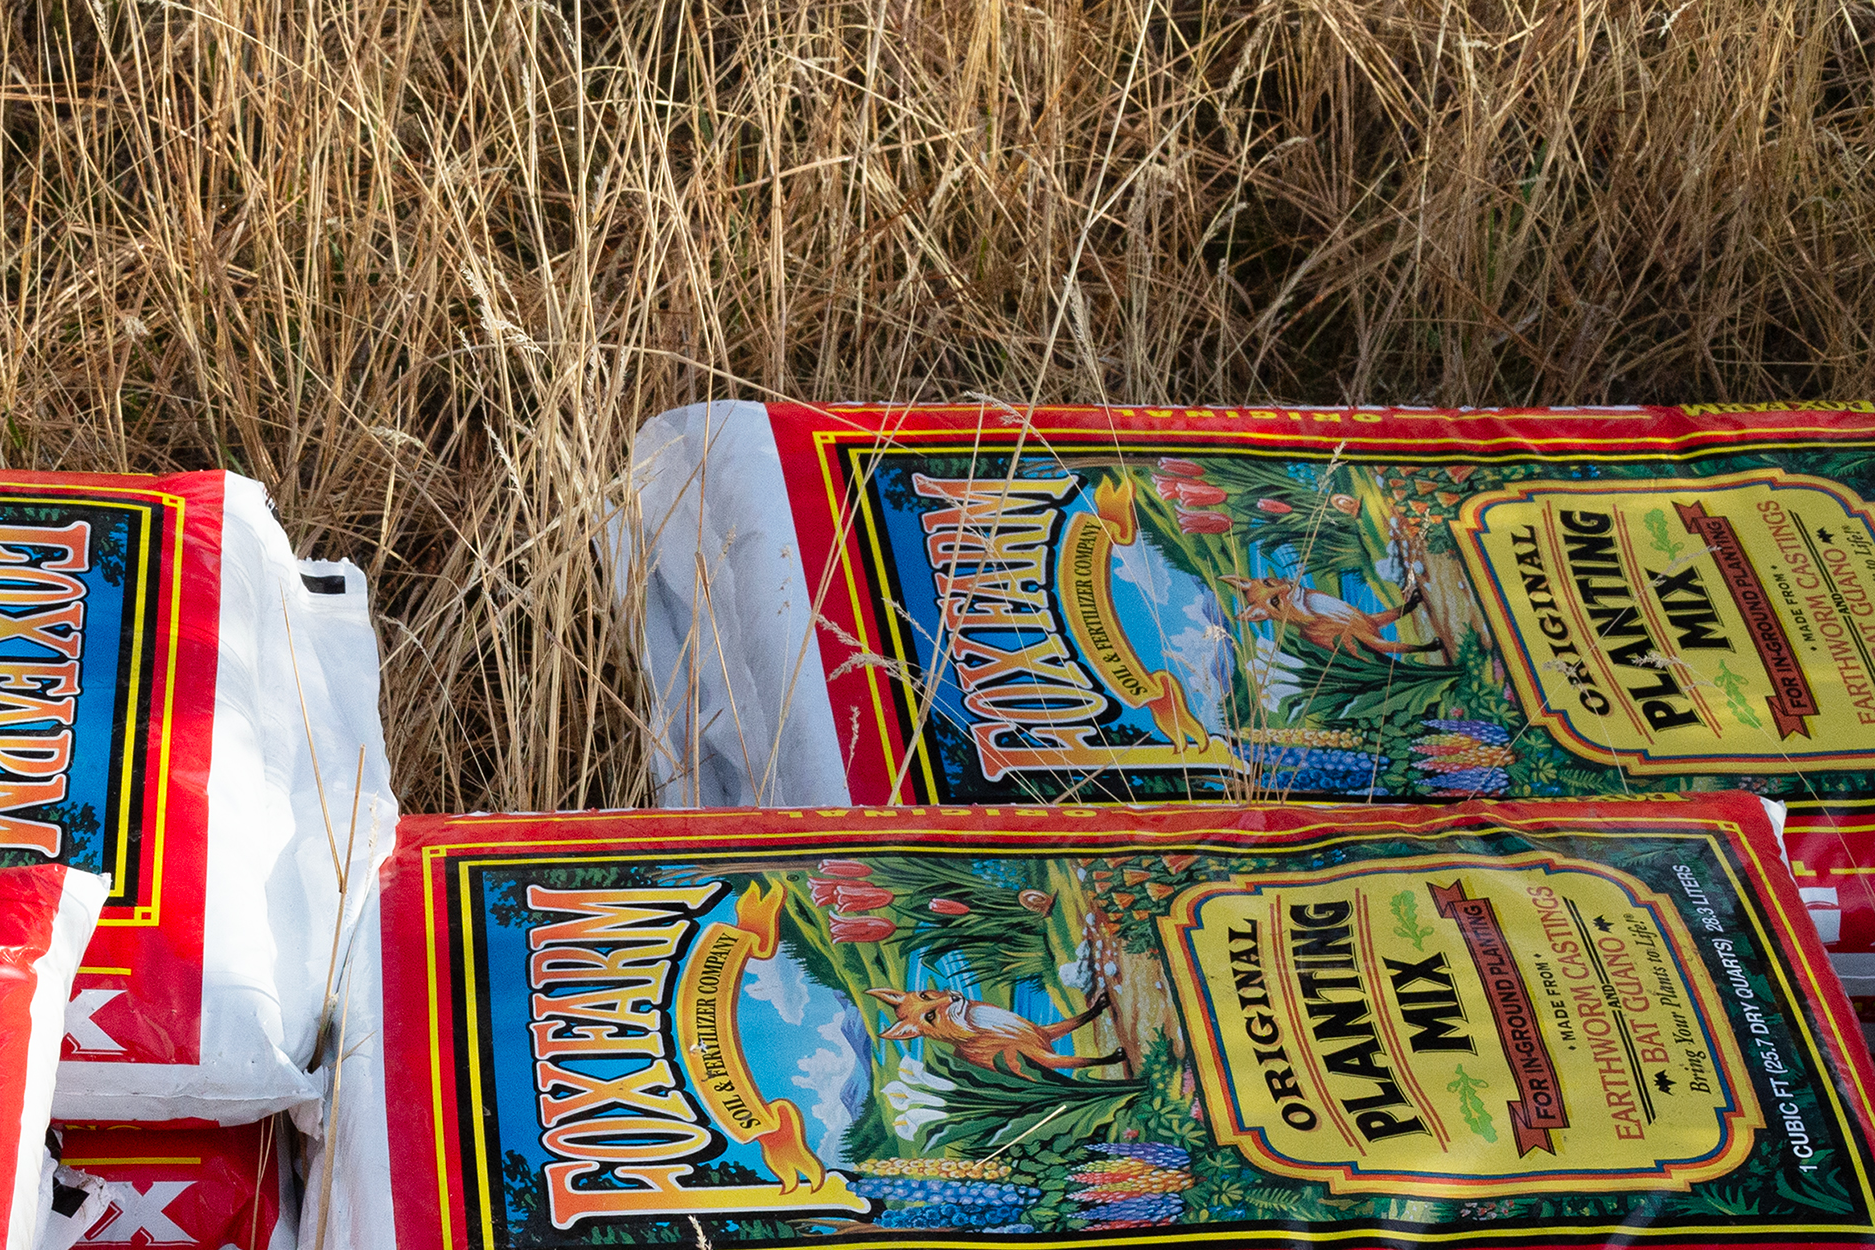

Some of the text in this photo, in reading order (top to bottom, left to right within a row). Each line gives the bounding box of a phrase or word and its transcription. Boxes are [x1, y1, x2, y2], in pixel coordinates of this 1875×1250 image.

[912, 473, 1249, 782] FOXFARM
[1074, 521, 1148, 696] SOIL FERTILIZER COMPANY
[1512, 524, 1613, 717] ORIGINAL
[1559, 508, 1707, 733] PLANTING
[1645, 565, 1737, 654] MIX
[1707, 521, 1808, 710] FOR IN-GROUND PLANTING
[1757, 499, 1875, 725] EARTHWORM CASTINGS
[1774, 573, 1816, 642] MADE FROM
[1823, 548, 1873, 617] GUANO
[1831, 592, 1851, 615] AND
[526, 882, 871, 1229] FOXFARM
[695, 932, 761, 1130] SOIL & FERTILIZER COMPANY
[1228, 918, 1320, 1132] ORIGINAL
[1289, 900, 1434, 1144] PLANTING
[1382, 951, 1478, 1056] MIX
[1464, 905, 1556, 1120] FOR IN-GROUND PLANTING
[1527, 885, 1646, 1141] EARTHWORM CASTINGS
[1535, 962, 1574, 1041] MADE FROM
[1599, 937, 1669, 1064] BAT GUANO
[1605, 984, 1621, 1010] AND
[1651, 950, 1711, 1094] Bring Your Plants to
[1673, 865, 1813, 1160] CUBIC FT (25.7 DRY QUARTS) 28.3 LITERS
